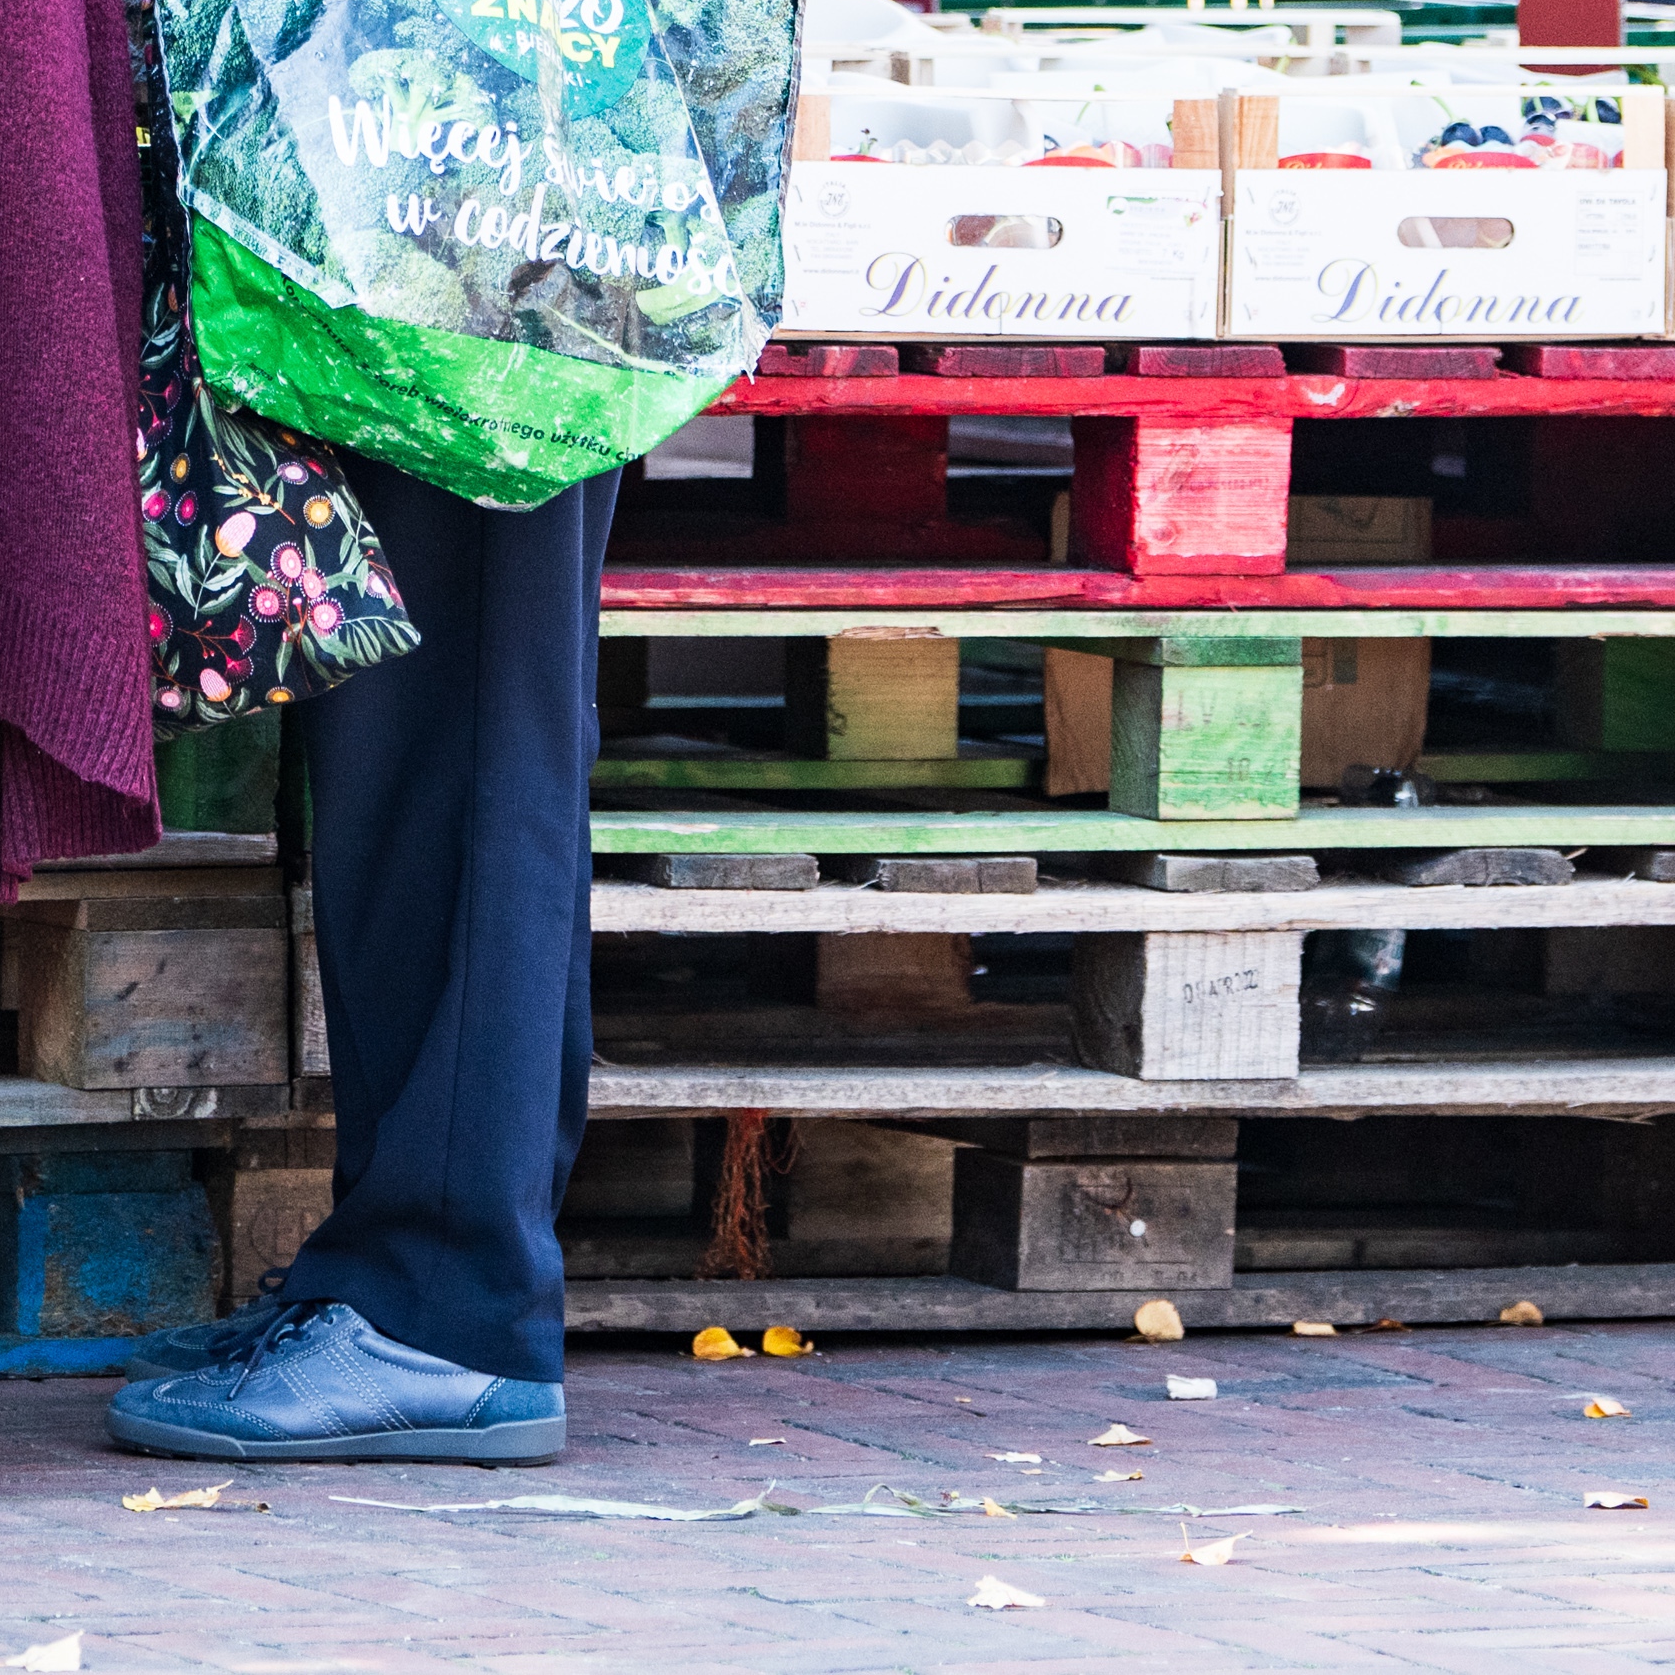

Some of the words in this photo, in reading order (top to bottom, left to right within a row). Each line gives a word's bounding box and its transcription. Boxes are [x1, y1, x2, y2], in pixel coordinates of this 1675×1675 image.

[328, 94, 532, 196] Więcej
[387, 193, 442, 236] w
[859, 252, 1135, 323] Didonna
[1311, 258, 1584, 324] Didonna
[424, 394, 545, 441] wielokrotnego
[550, 430, 610, 457] użytku
